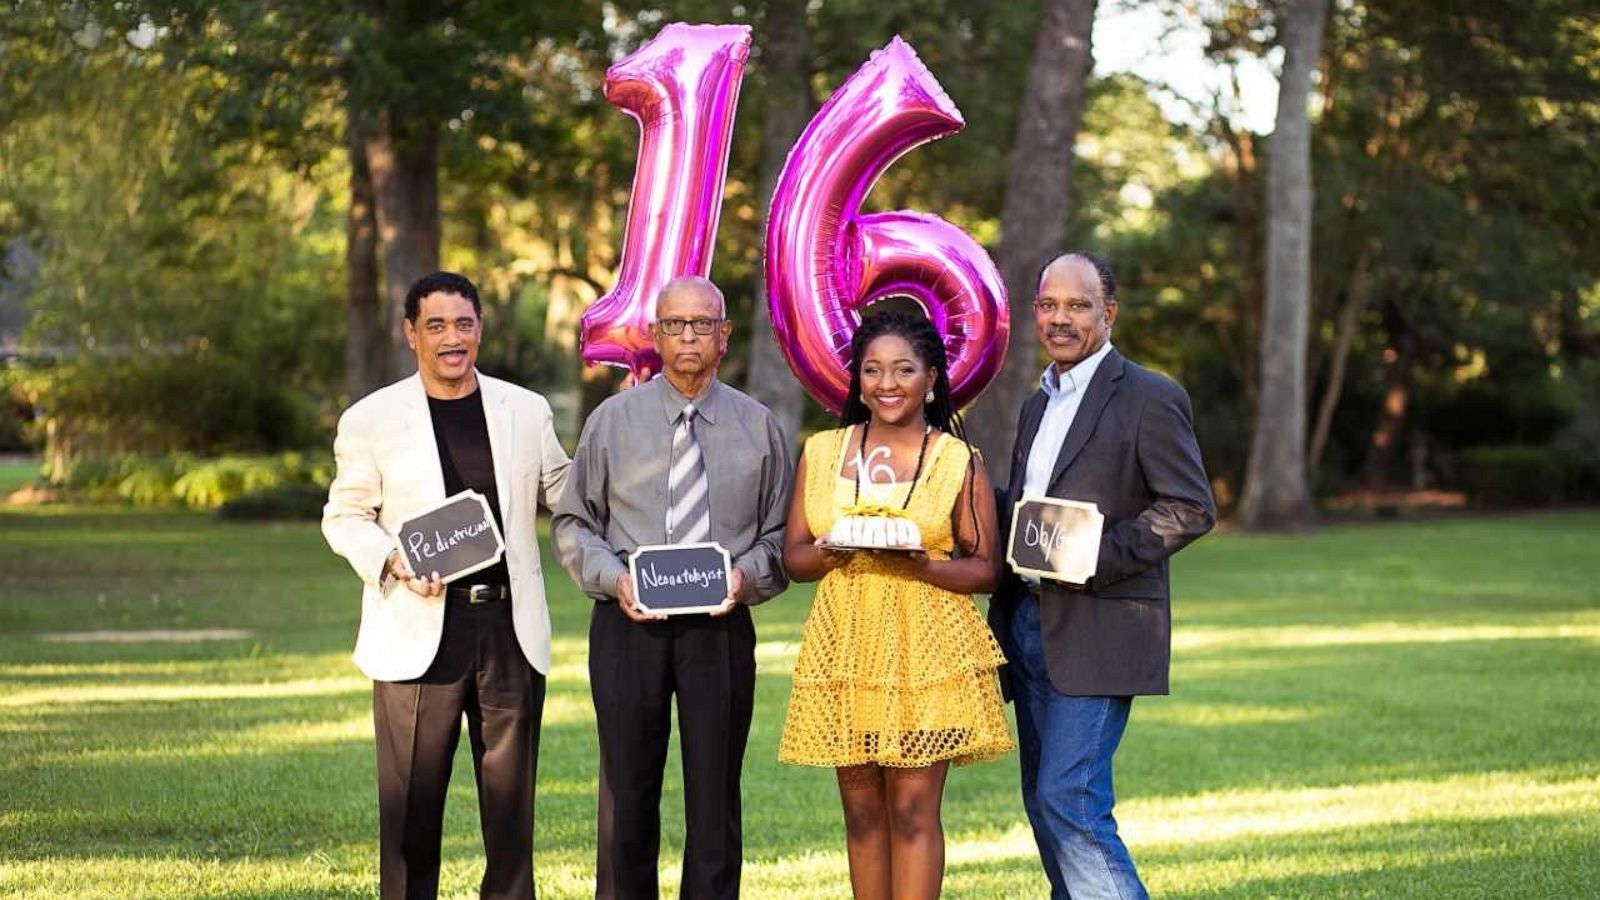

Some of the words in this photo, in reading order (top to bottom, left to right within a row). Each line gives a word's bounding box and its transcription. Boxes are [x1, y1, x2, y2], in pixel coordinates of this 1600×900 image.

[580, 23, 1010, 417] 16
[847, 445, 897, 504] 16
[408, 520, 491, 562] Pediatrician
[641, 562, 725, 590] Neonatologist
